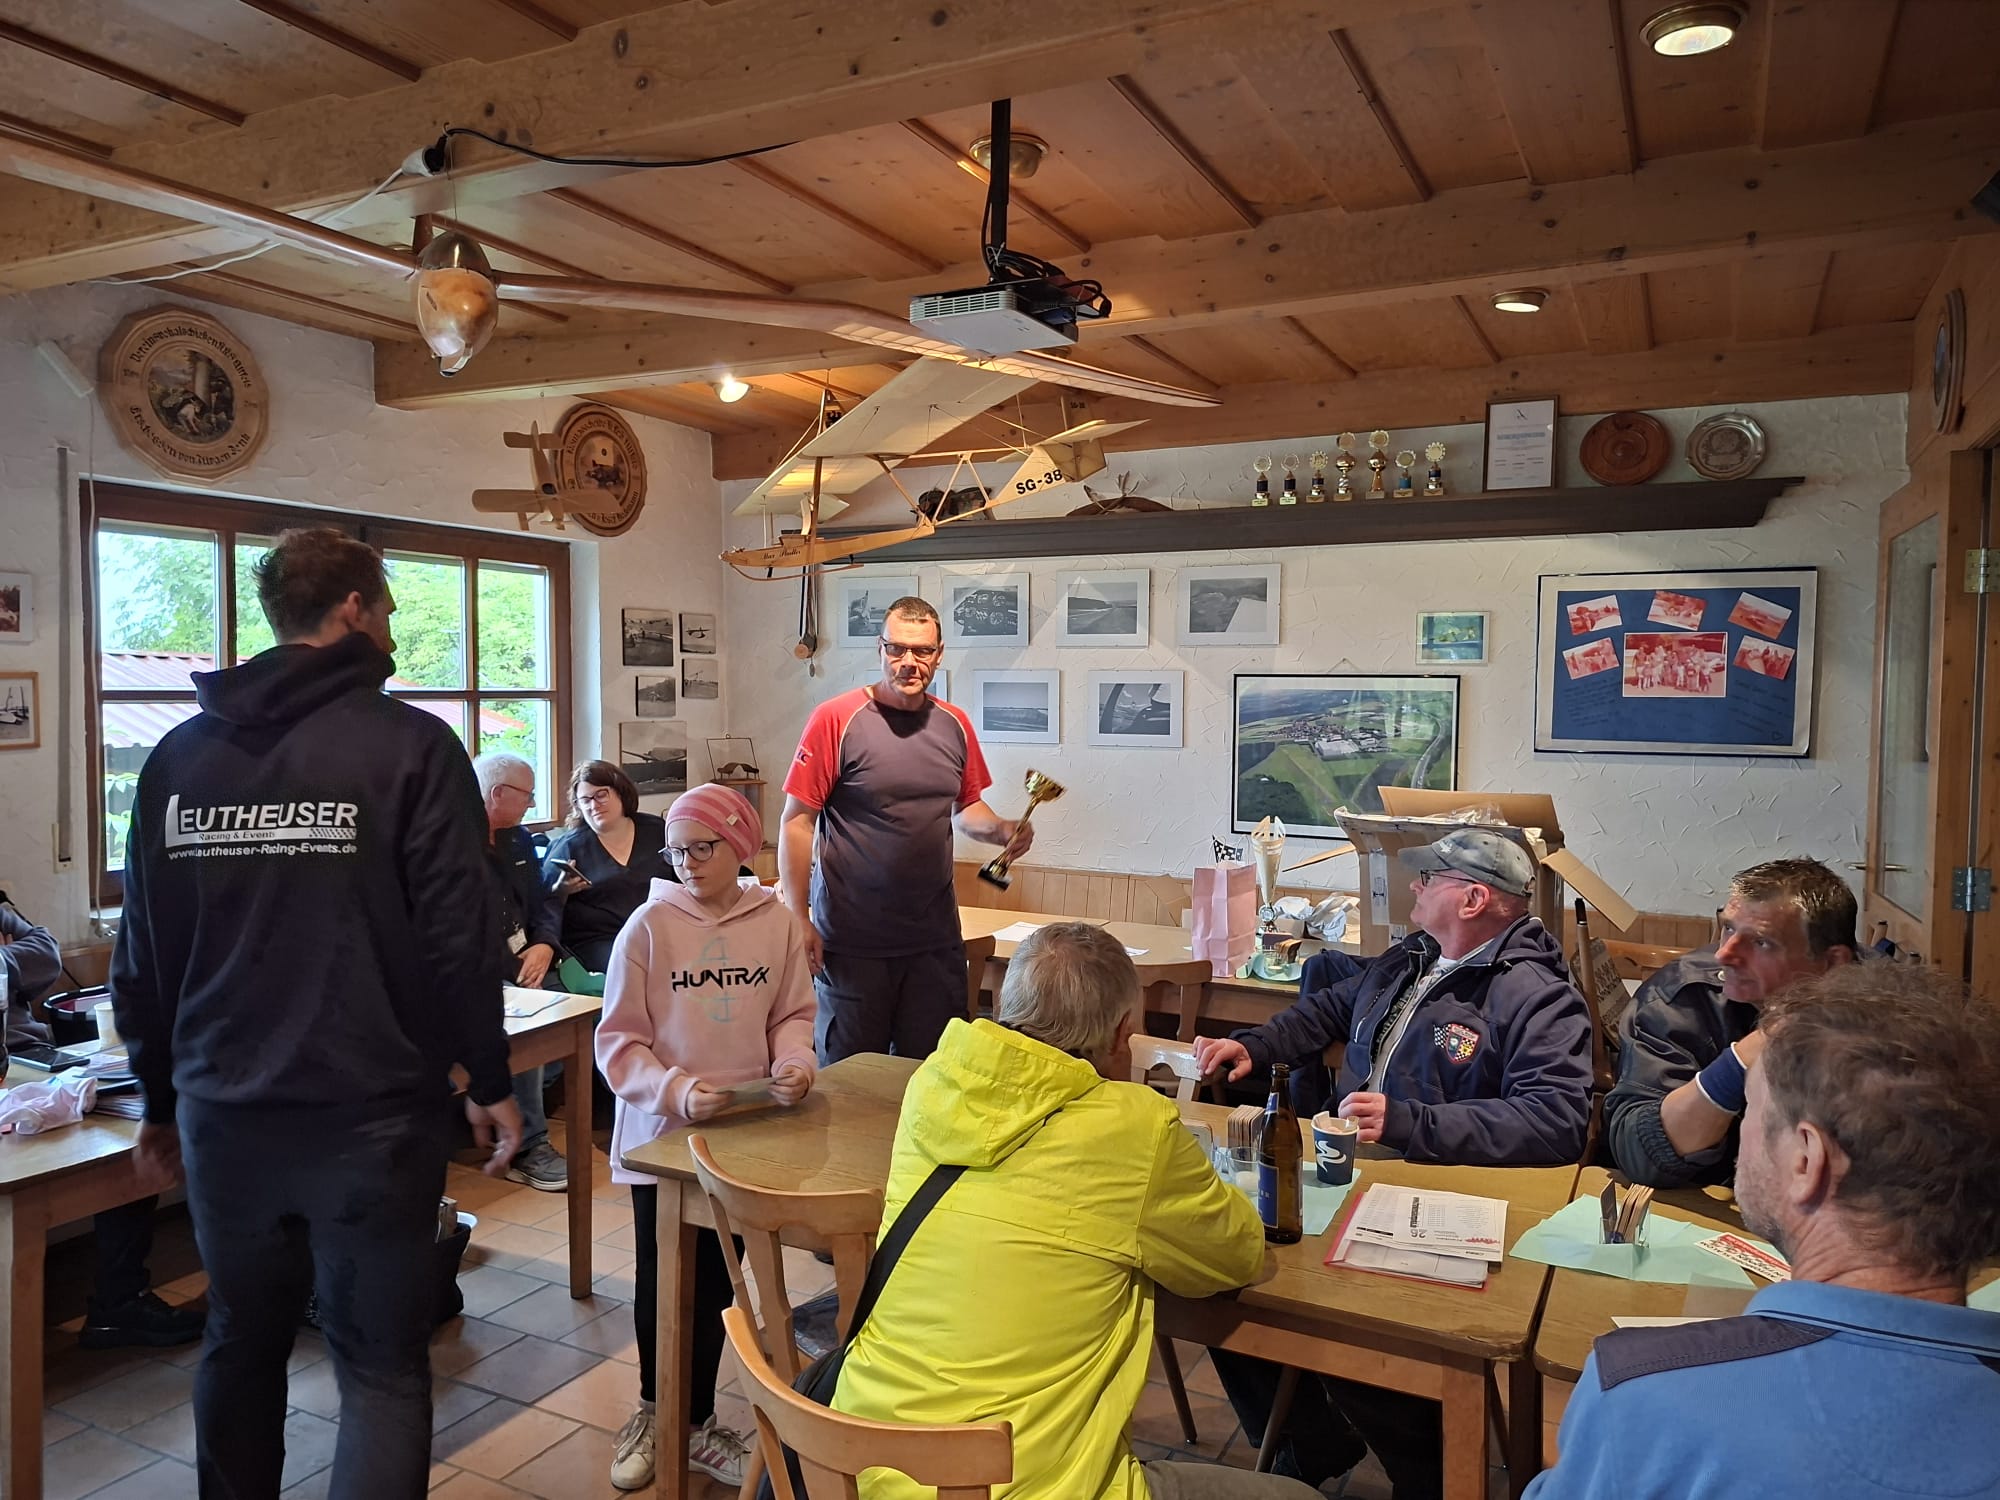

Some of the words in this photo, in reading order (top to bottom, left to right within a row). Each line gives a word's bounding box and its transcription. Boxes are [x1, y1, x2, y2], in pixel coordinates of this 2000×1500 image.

[1016, 469, 1063, 495] SG-38
[198, 832, 231, 842] Racing
[233, 831, 240, 840] &
